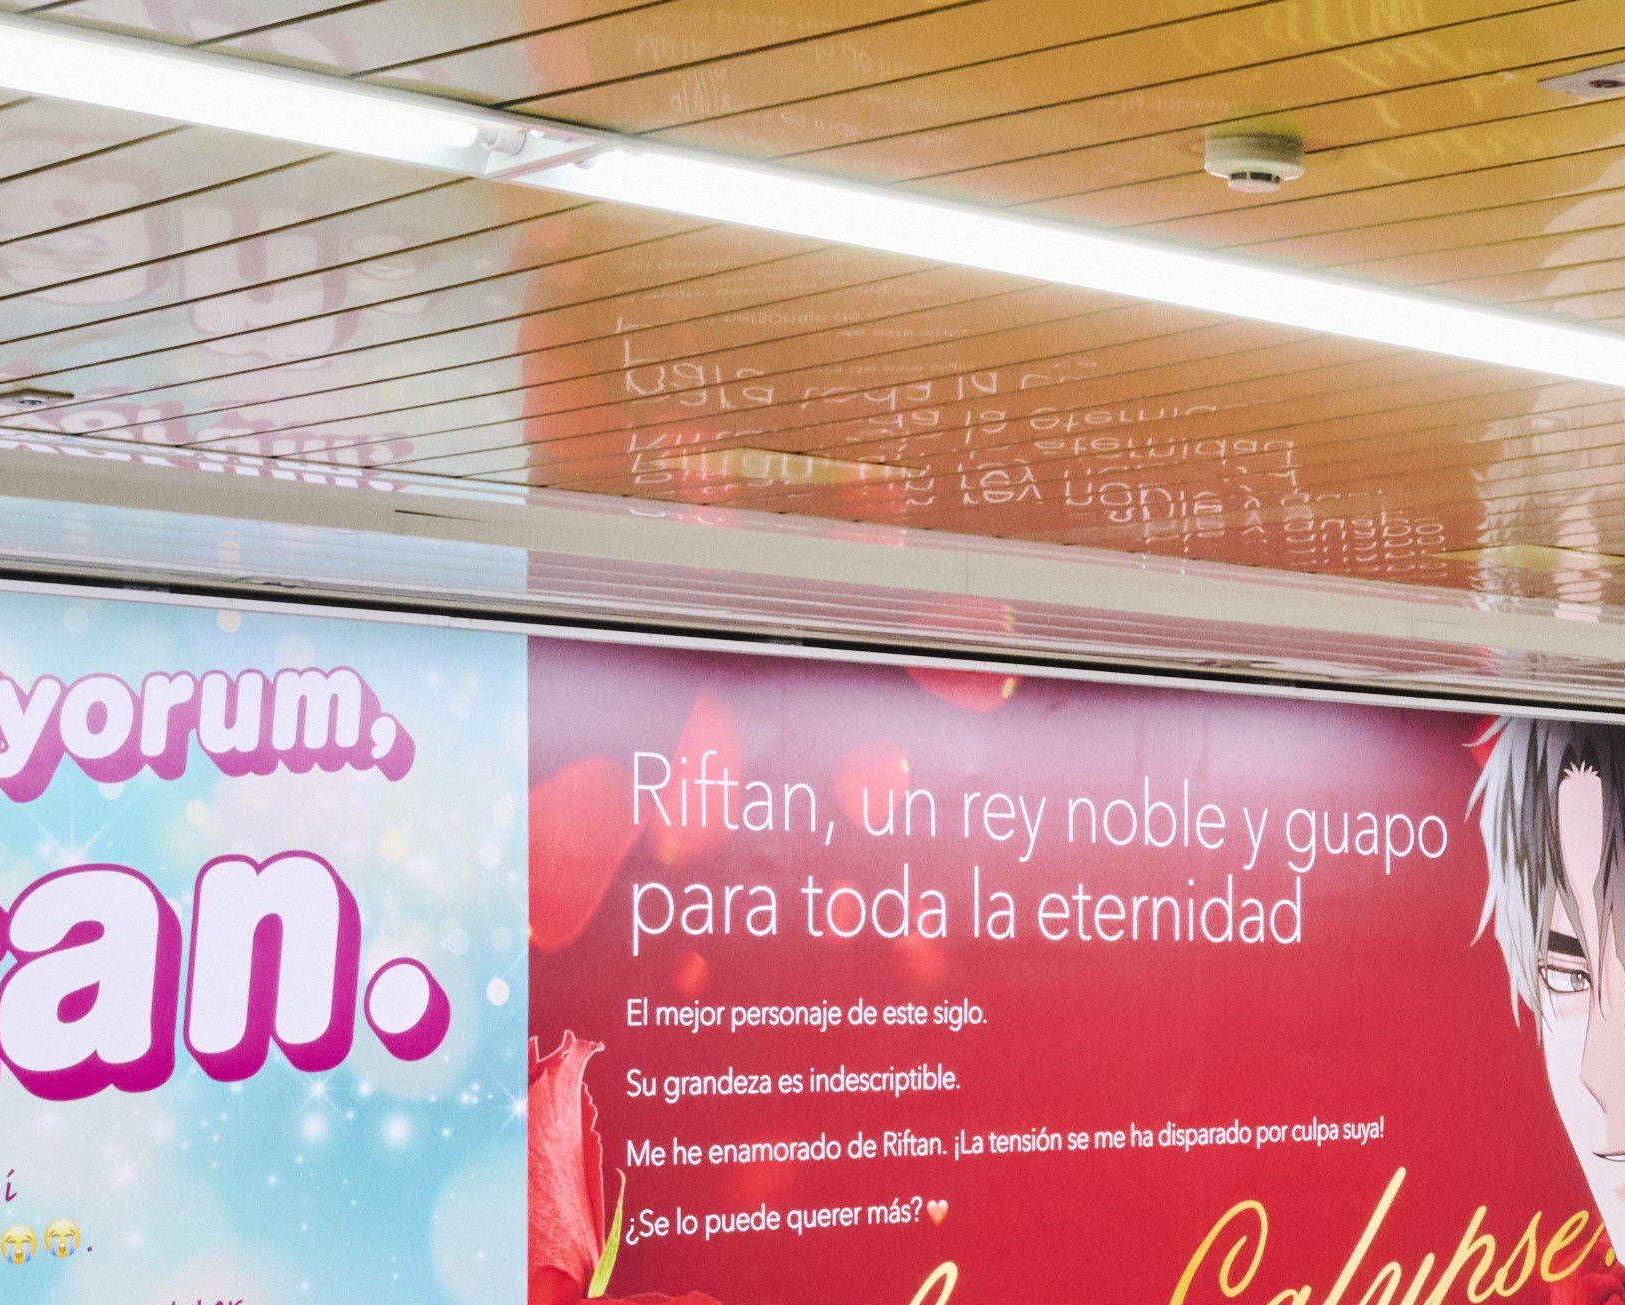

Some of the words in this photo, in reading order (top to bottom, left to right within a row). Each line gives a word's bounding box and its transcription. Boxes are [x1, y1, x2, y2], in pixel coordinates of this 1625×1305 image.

[632, 750, 836, 847] Riftan,
[863, 785, 936, 837] un
[964, 790, 1046, 862] rey
[1068, 776, 1226, 851] noble
[1243, 804, 1270, 869] y
[1286, 806, 1448, 875] guapo
[632, 879, 778, 957] para
[801, 863, 947, 938] toda
[973, 866, 1015, 939] la
[1037, 873, 1302, 944] eternidad
[626, 998, 648, 1027] El
[656, 999, 725, 1033] mejor
[731, 999, 841, 1033] personaje
[848, 997, 876, 1026] de
[883, 1003, 928, 1026] este
[933, 997, 988, 1032] siglo.
[626, 1068, 657, 1098] Su
[663, 1066, 772, 1104] grandeza
[778, 1073, 803, 1094] es
[809, 1063, 961, 1098] indescriptible.
[626, 1139, 666, 1168] Me
[673, 1136, 702, 1166] he
[708, 1131, 842, 1164] enamorado
[847, 1131, 877, 1160] de
[883, 1129, 948, 1158] Riftan.
[954, 1128, 983, 1161] ¡La
[989, 1126, 1062, 1154] tensión
[1067, 1129, 1089, 1151] se
[1094, 1128, 1126, 1149] me
[1130, 1122, 1153, 1148] ha
[1158, 1118, 1252, 1153] disparado
[1256, 1123, 1287, 1150] por
[1291, 1116, 1339, 1148] culpa
[1342, 1115, 1385, 1146] suya!
[625, 1207, 669, 1246] ¿Se
[676, 1206, 698, 1235] lo
[705, 1202, 781, 1241] puede
[787, 1205, 864, 1236] querer
[867, 1195, 924, 1225] más?
